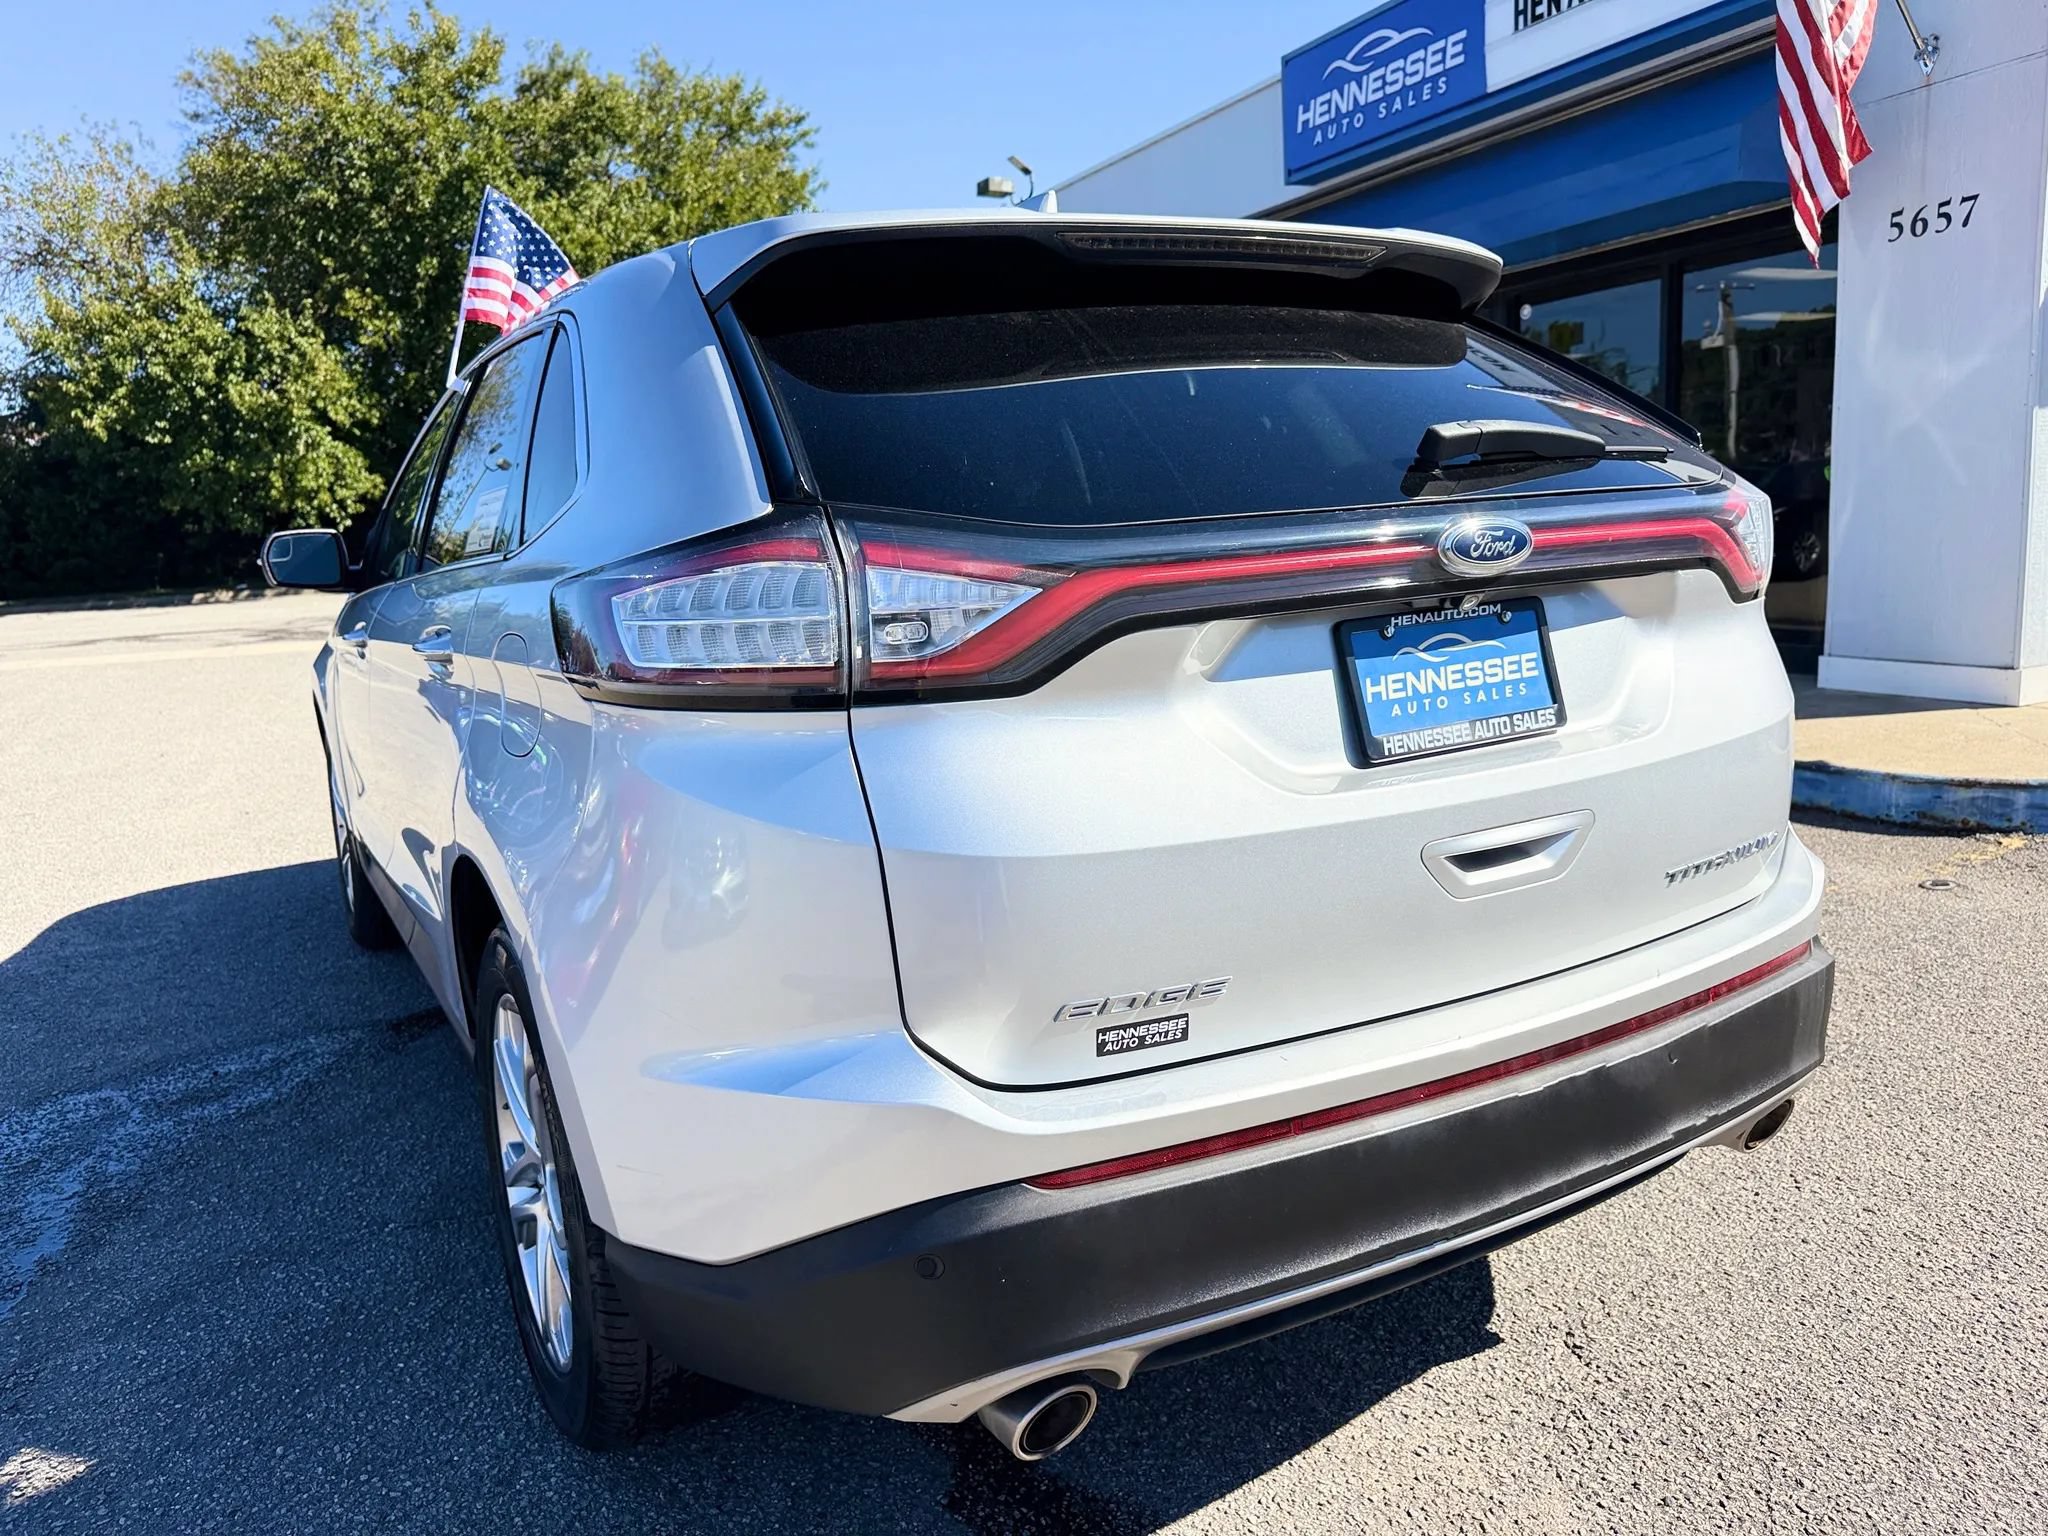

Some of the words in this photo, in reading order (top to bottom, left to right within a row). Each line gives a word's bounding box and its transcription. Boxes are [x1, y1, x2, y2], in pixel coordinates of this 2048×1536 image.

[1296, 29, 1467, 134] HENNESSEE
[1313, 114, 1365, 146] AUTO
[1378, 76, 1448, 119] SALES
[1888, 193, 1980, 242] 5657
[1470, 529, 1516, 558] Ford
[1390, 603, 1501, 627] HENAUTO.COM
[1365, 652, 1539, 704] HENNESSEE
[1391, 696, 1449, 717] AUTO
[1463, 683, 1527, 705] SALES
[1383, 723, 1473, 756] HENNESSEE
[1474, 715, 1512, 740] AUTO
[1513, 709, 1556, 732] SALES
[1664, 831, 1778, 887] TITANIUM
[1053, 976, 1233, 1022] EDGE
[1097, 1017, 1188, 1044] HENNESSEE
[1103, 1037, 1139, 1052] AUTO
[1144, 1028, 1182, 1045] SALES
